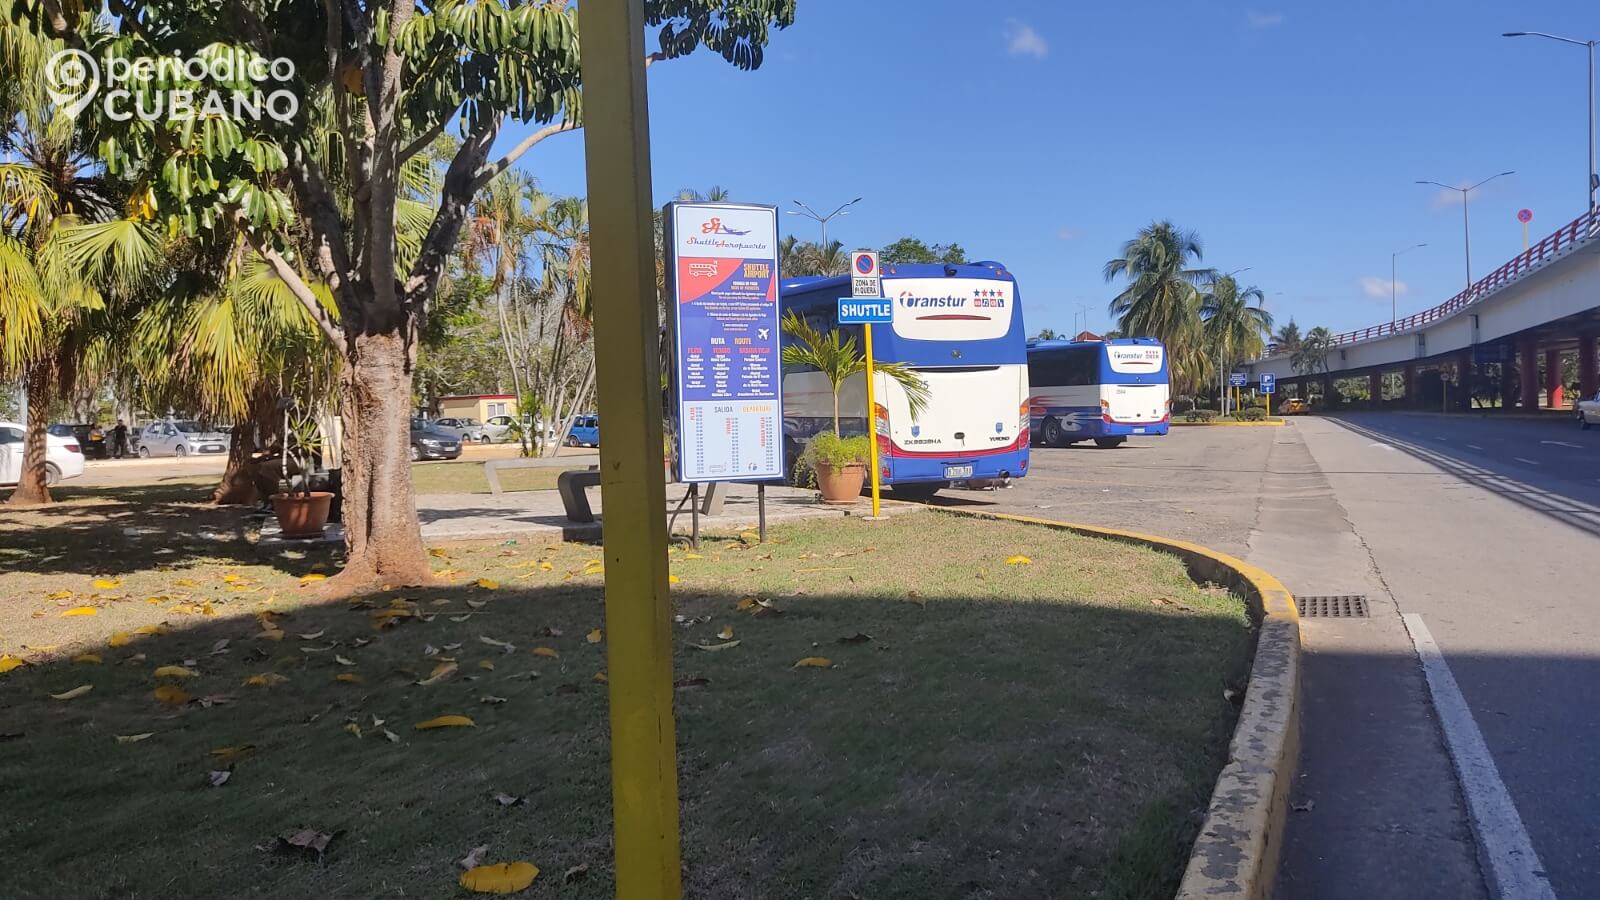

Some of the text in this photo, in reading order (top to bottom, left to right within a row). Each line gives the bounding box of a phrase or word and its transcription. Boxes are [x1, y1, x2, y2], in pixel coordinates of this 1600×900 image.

[855, 279, 877, 287] ZONA DE
[854, 287, 877, 295] PIQUERA
[841, 303, 891, 317] SHUTTLE
[710, 337, 726, 345] RUTA
